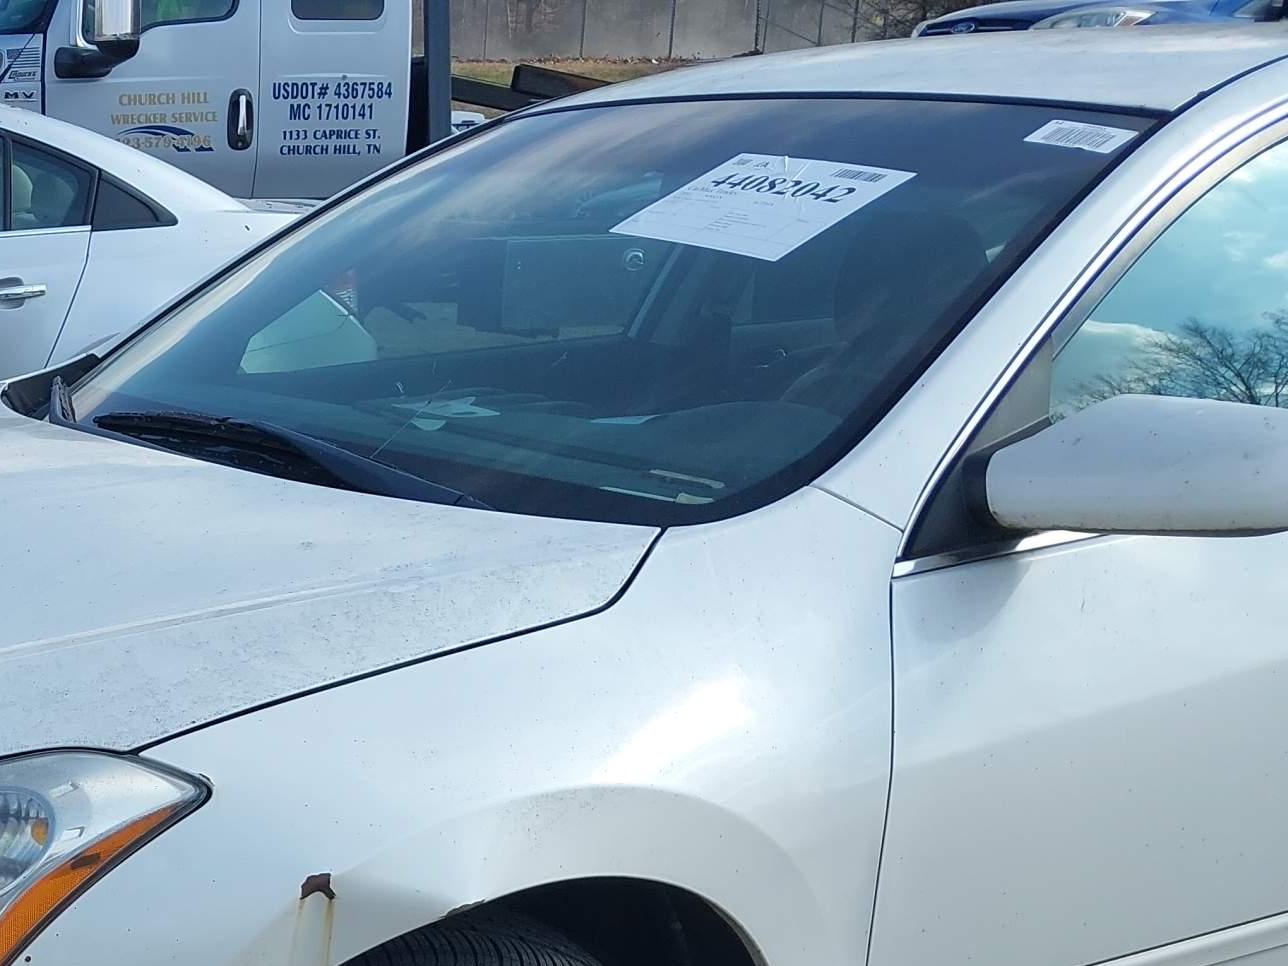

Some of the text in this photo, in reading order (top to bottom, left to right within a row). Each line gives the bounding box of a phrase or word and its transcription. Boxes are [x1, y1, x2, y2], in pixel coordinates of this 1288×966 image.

[119, 91, 209, 106] CHURCH HILL
[272, 82, 392, 100] USDOT# 4367584
[111, 111, 218, 125] WRECKER SERVICE
[289, 103, 374, 120] MC 1710141
[282, 129, 381, 141] 1133 CAPRICE ST.
[279, 144, 382, 156] CHURCH HILL, TN
[712, 172, 857, 204] 44082042
